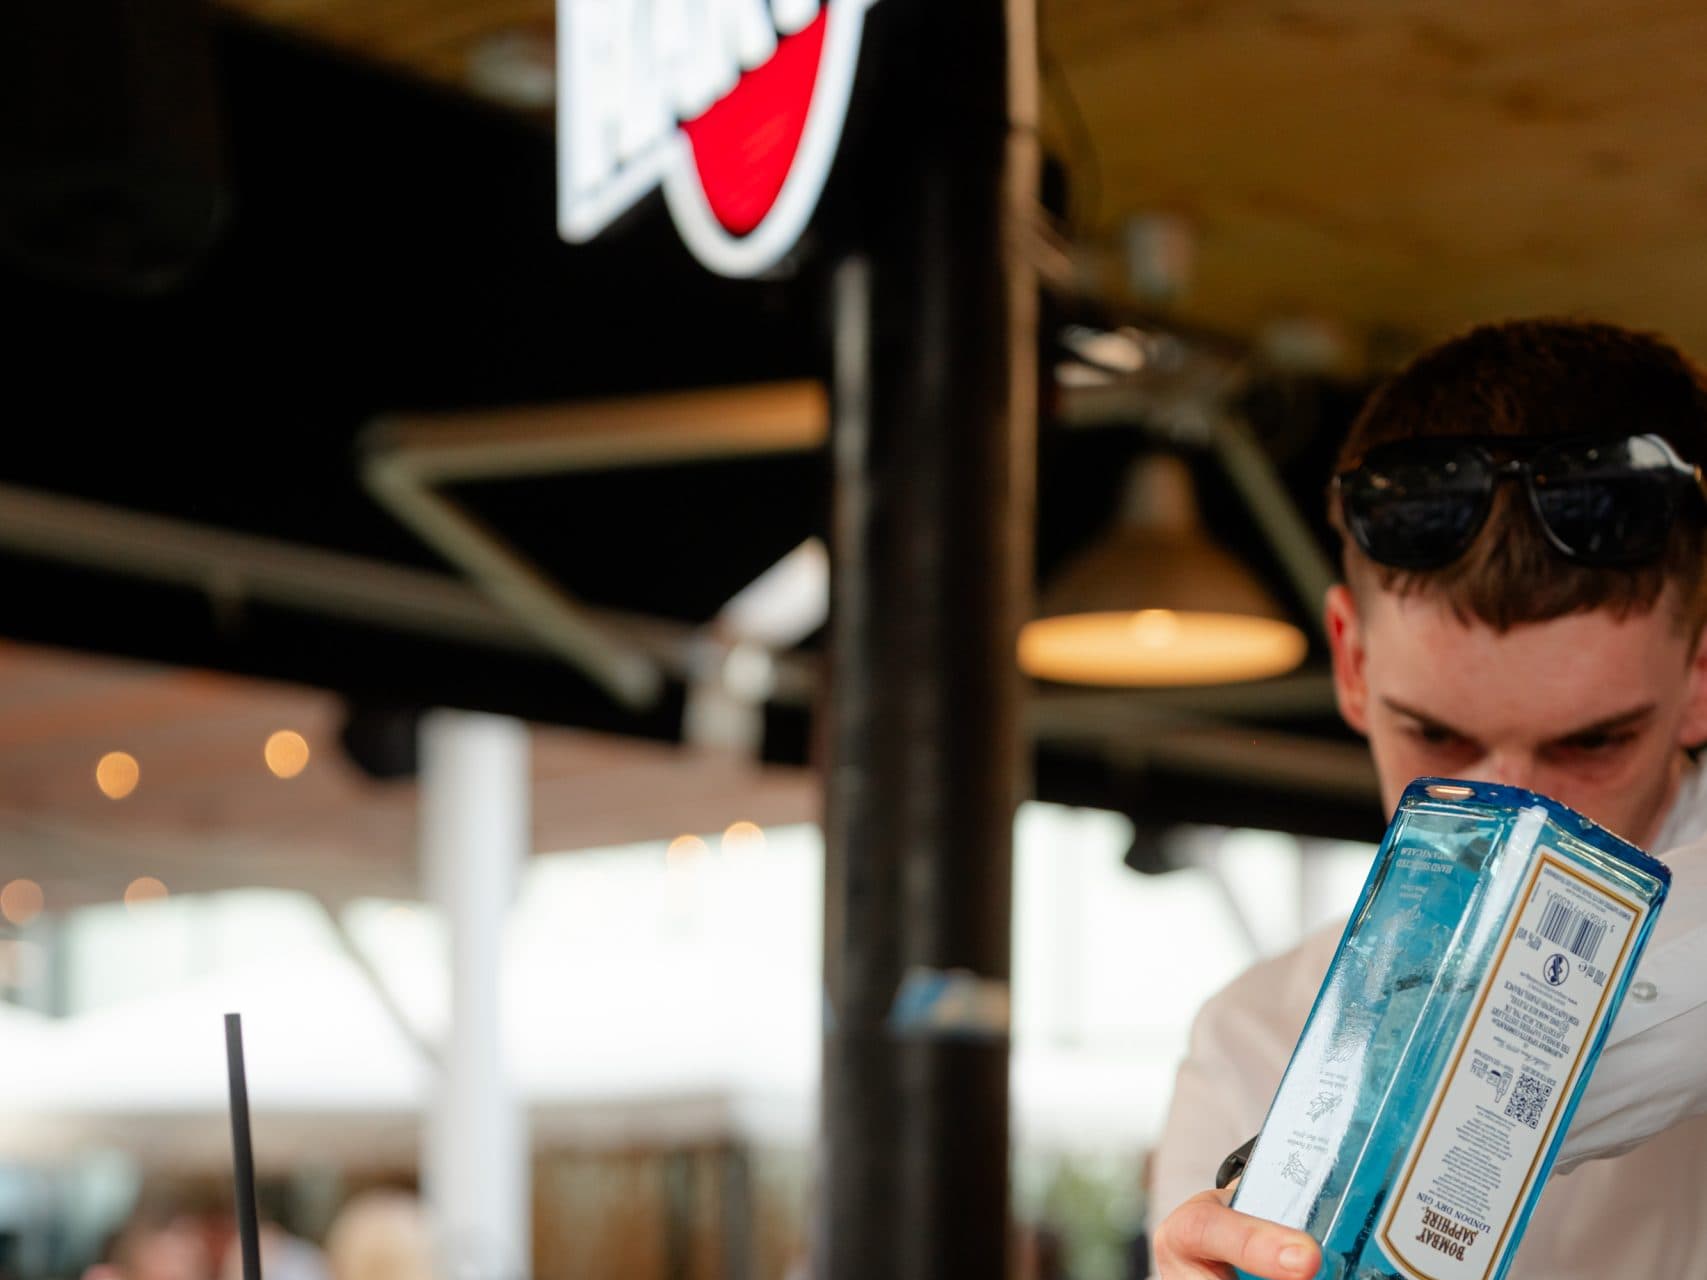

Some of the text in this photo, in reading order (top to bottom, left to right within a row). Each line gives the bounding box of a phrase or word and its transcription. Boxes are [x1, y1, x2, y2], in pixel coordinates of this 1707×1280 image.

[1416, 1191, 1491, 1234] LONDON DRY GIN
[1422, 1206, 1479, 1246] SAPPHIRE
[1416, 1227, 1466, 1261] BOMBAY
